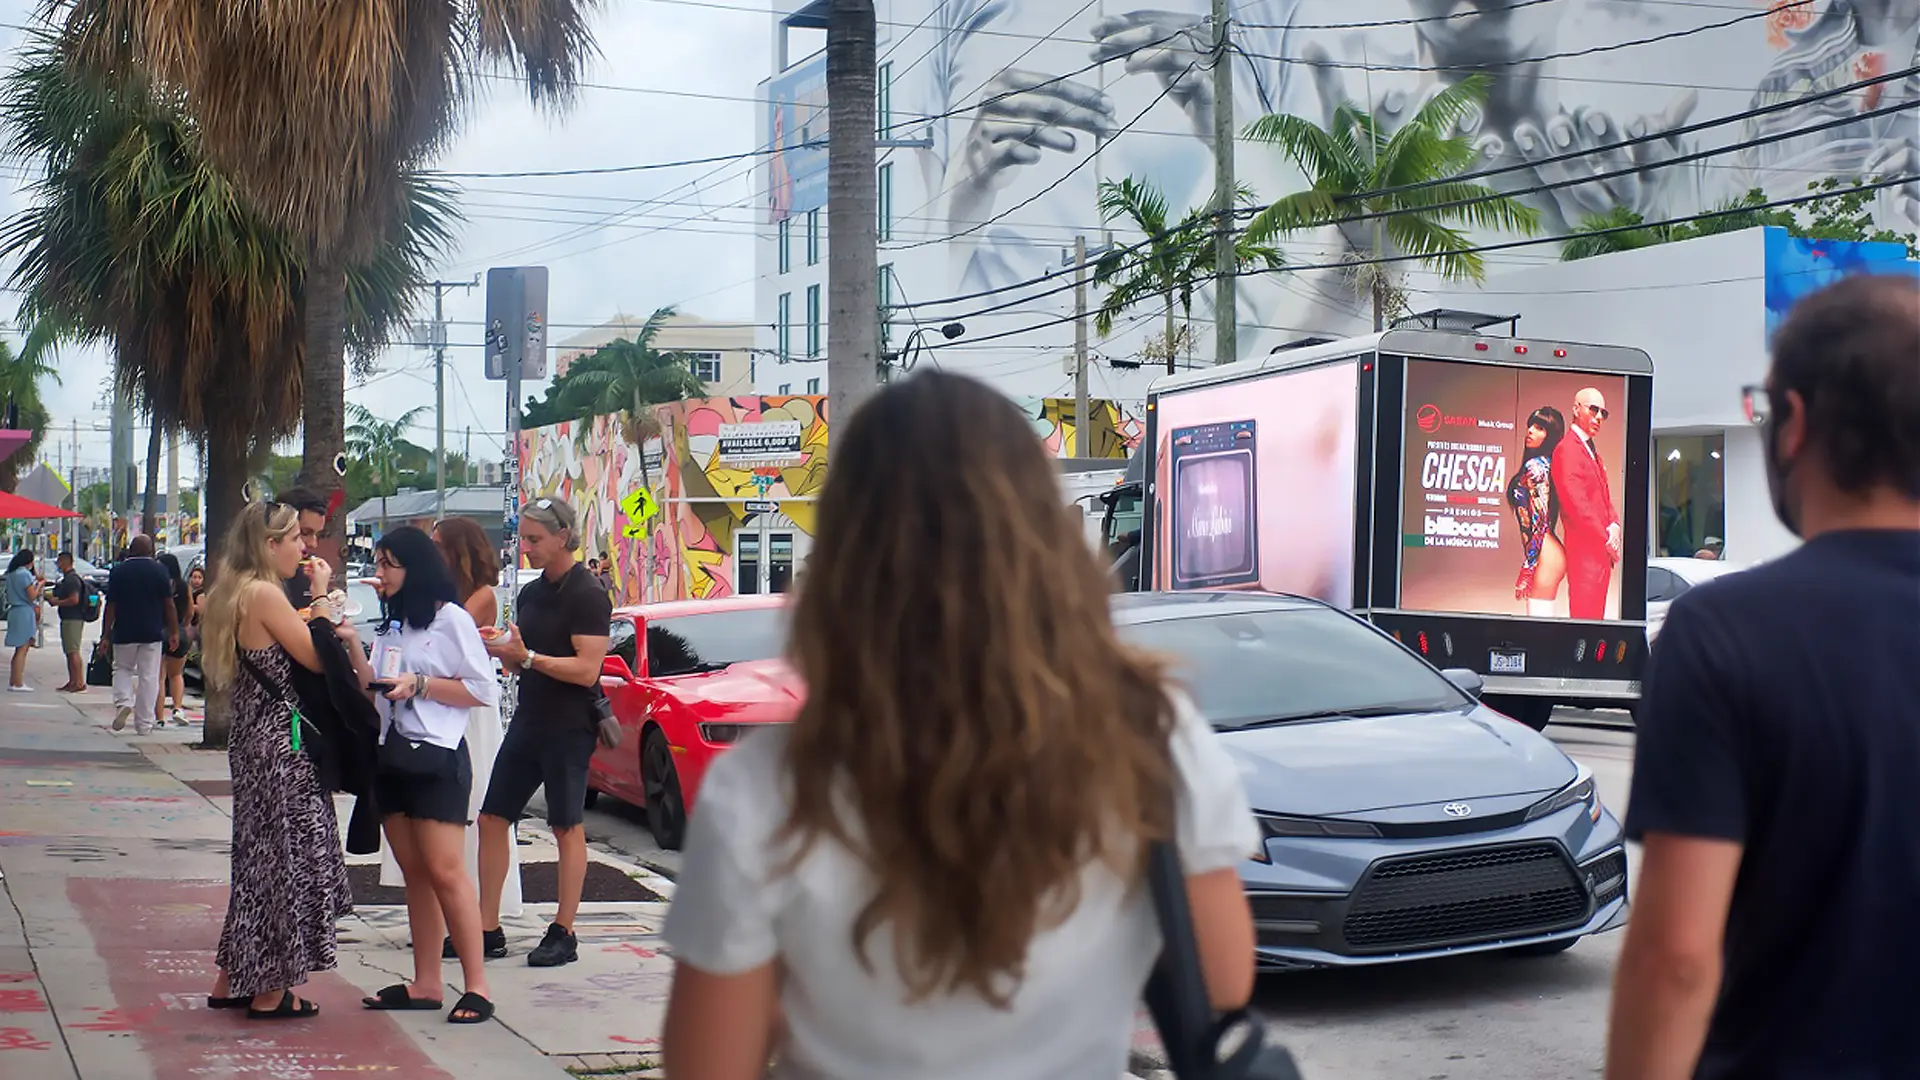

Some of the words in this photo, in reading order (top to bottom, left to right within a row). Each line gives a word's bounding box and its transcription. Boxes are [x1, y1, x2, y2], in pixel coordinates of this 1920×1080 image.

[1496, 420, 1515, 430] Group
[722, 438, 762, 448] AVAILABLE
[1422, 452, 1506, 493] CHESCA
[1443, 507, 1482, 517] PREMIOS
[1424, 515, 1499, 538] billboard
[1424, 536, 1434, 546] DE
[1435, 537, 1445, 546] LA
[1474, 539, 1499, 548] LATINA
